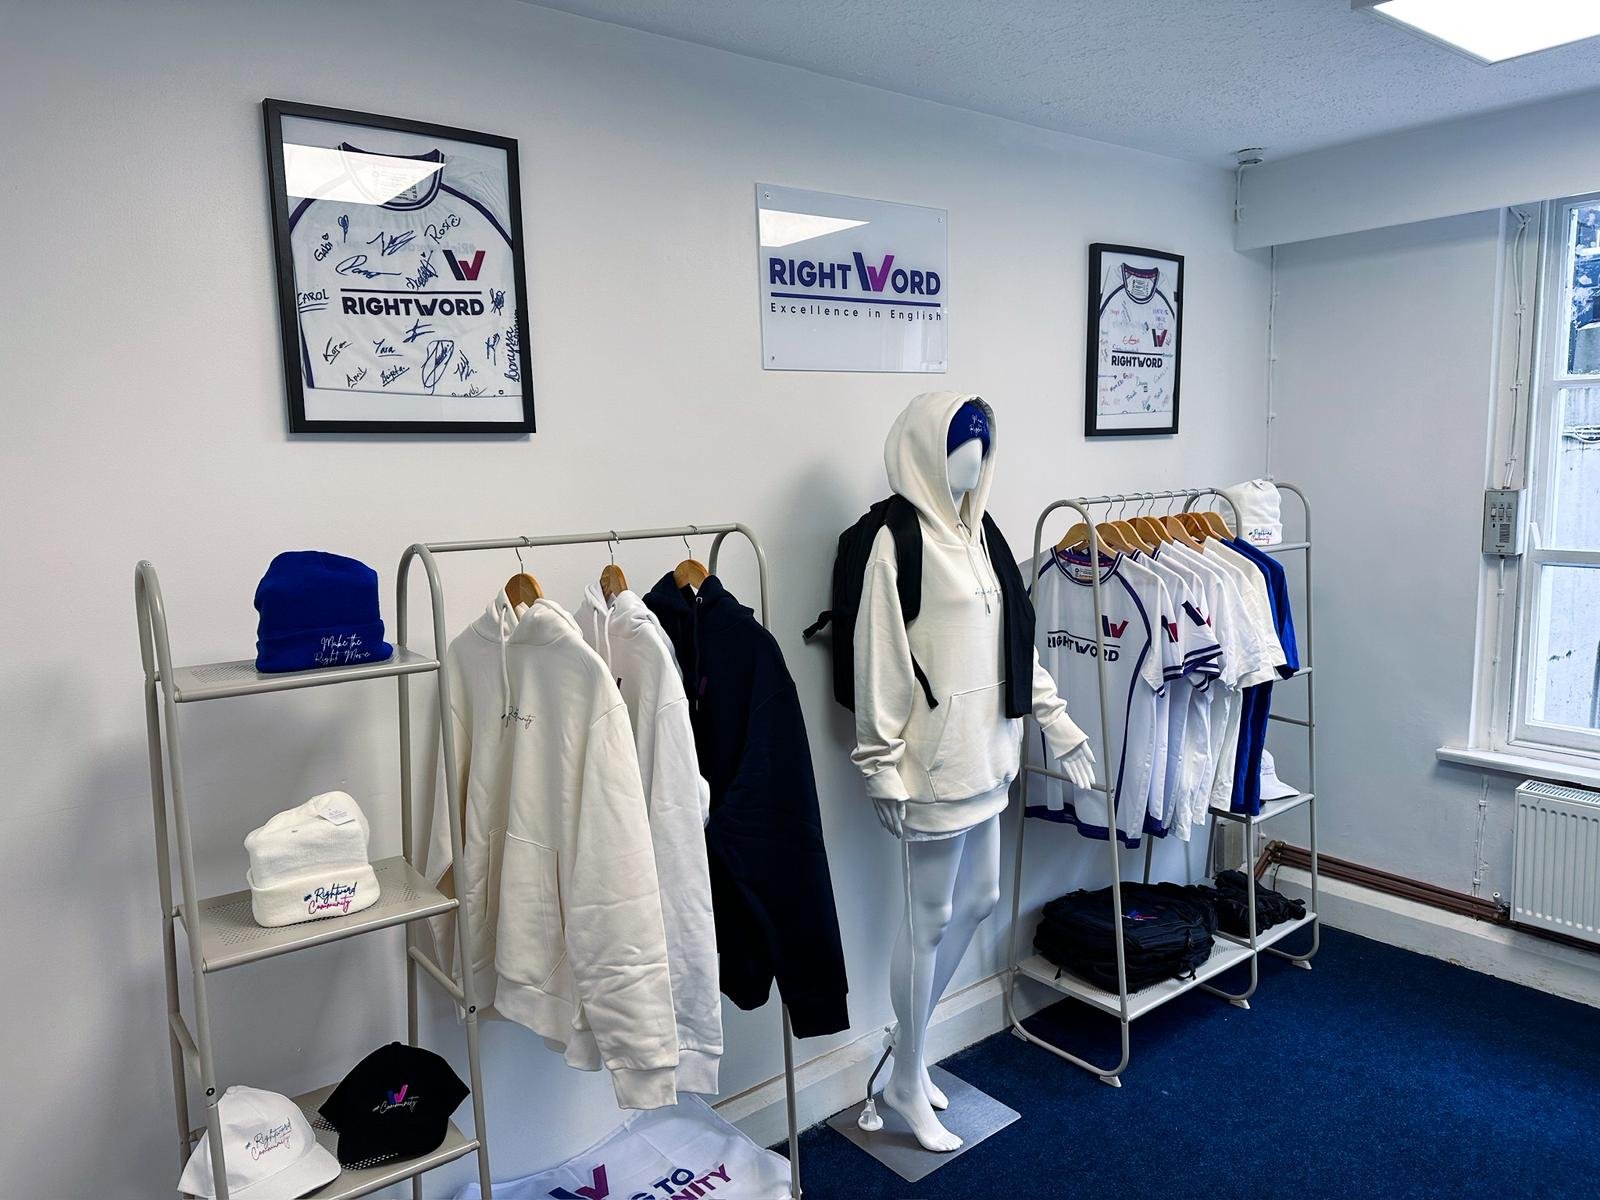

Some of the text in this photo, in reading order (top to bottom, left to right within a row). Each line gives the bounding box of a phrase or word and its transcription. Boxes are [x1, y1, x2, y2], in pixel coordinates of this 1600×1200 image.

[769, 251, 941, 296] RIGHTWORD
[341, 296, 485, 317] RIGHTWORD
[770, 302, 941, 322] Excellence in English
[1111, 355, 1163, 369] RIGHTWORD
[653, 1168, 695, 1195] TO
